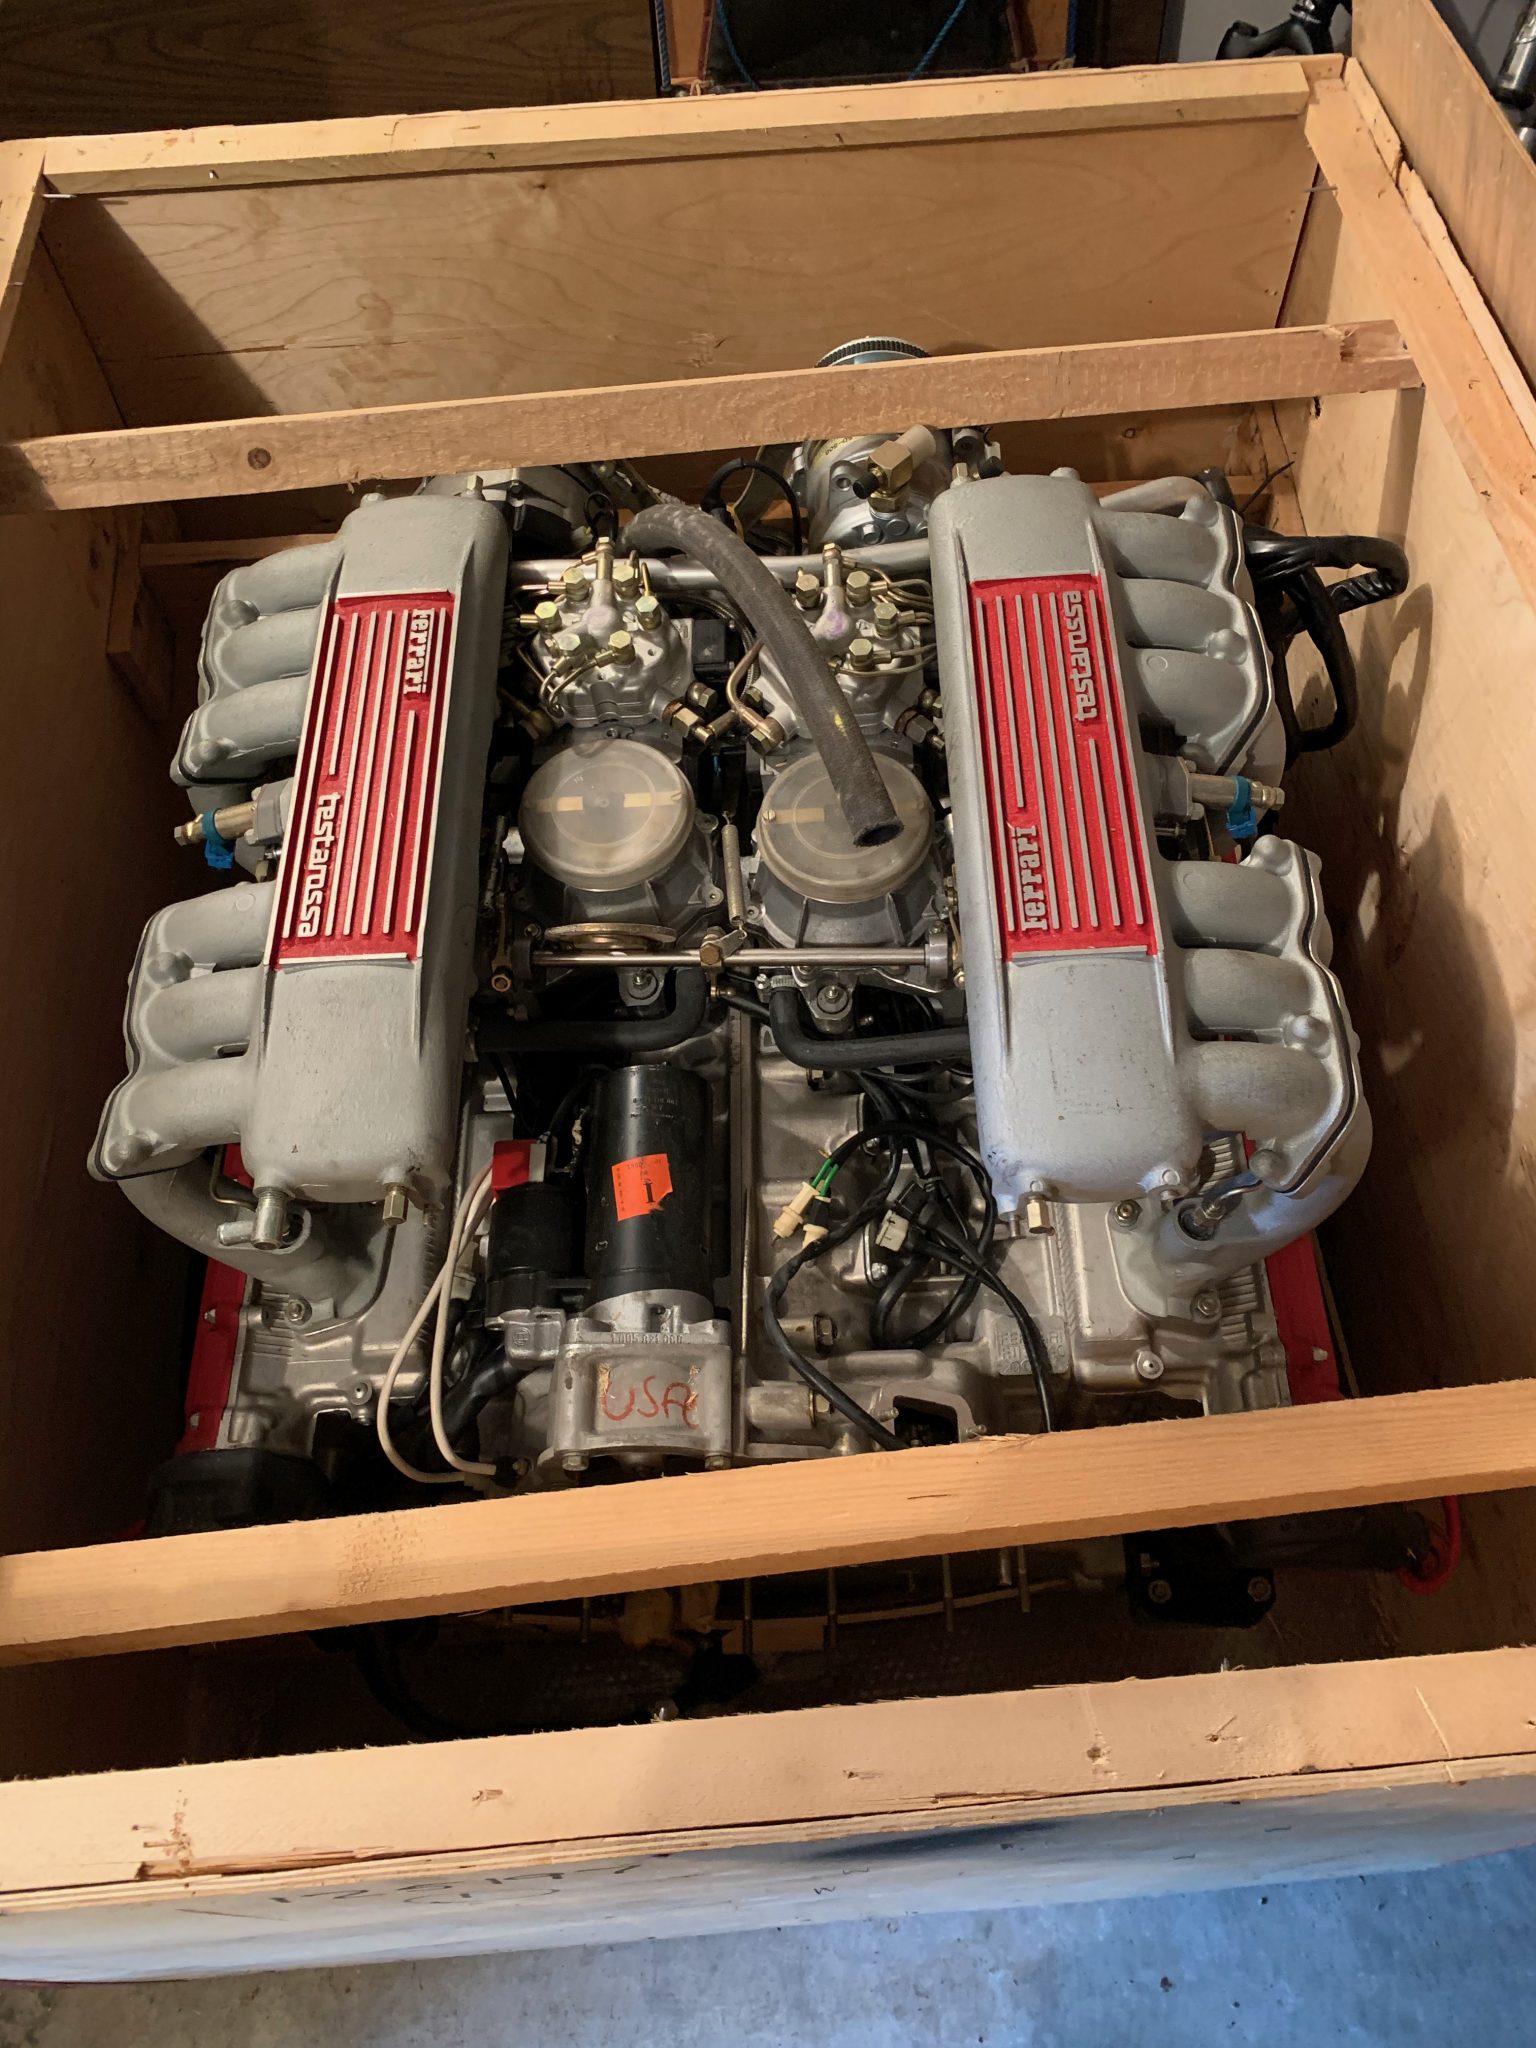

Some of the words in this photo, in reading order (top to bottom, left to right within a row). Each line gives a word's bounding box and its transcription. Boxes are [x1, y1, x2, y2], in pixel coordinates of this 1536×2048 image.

[403, 607, 435, 694] Ferrari
[1062, 590, 1098, 722] testarossa
[298, 791, 341, 938] testarossa
[1011, 825, 1048, 931] Ferrari
[601, 1375, 700, 1430] USA
